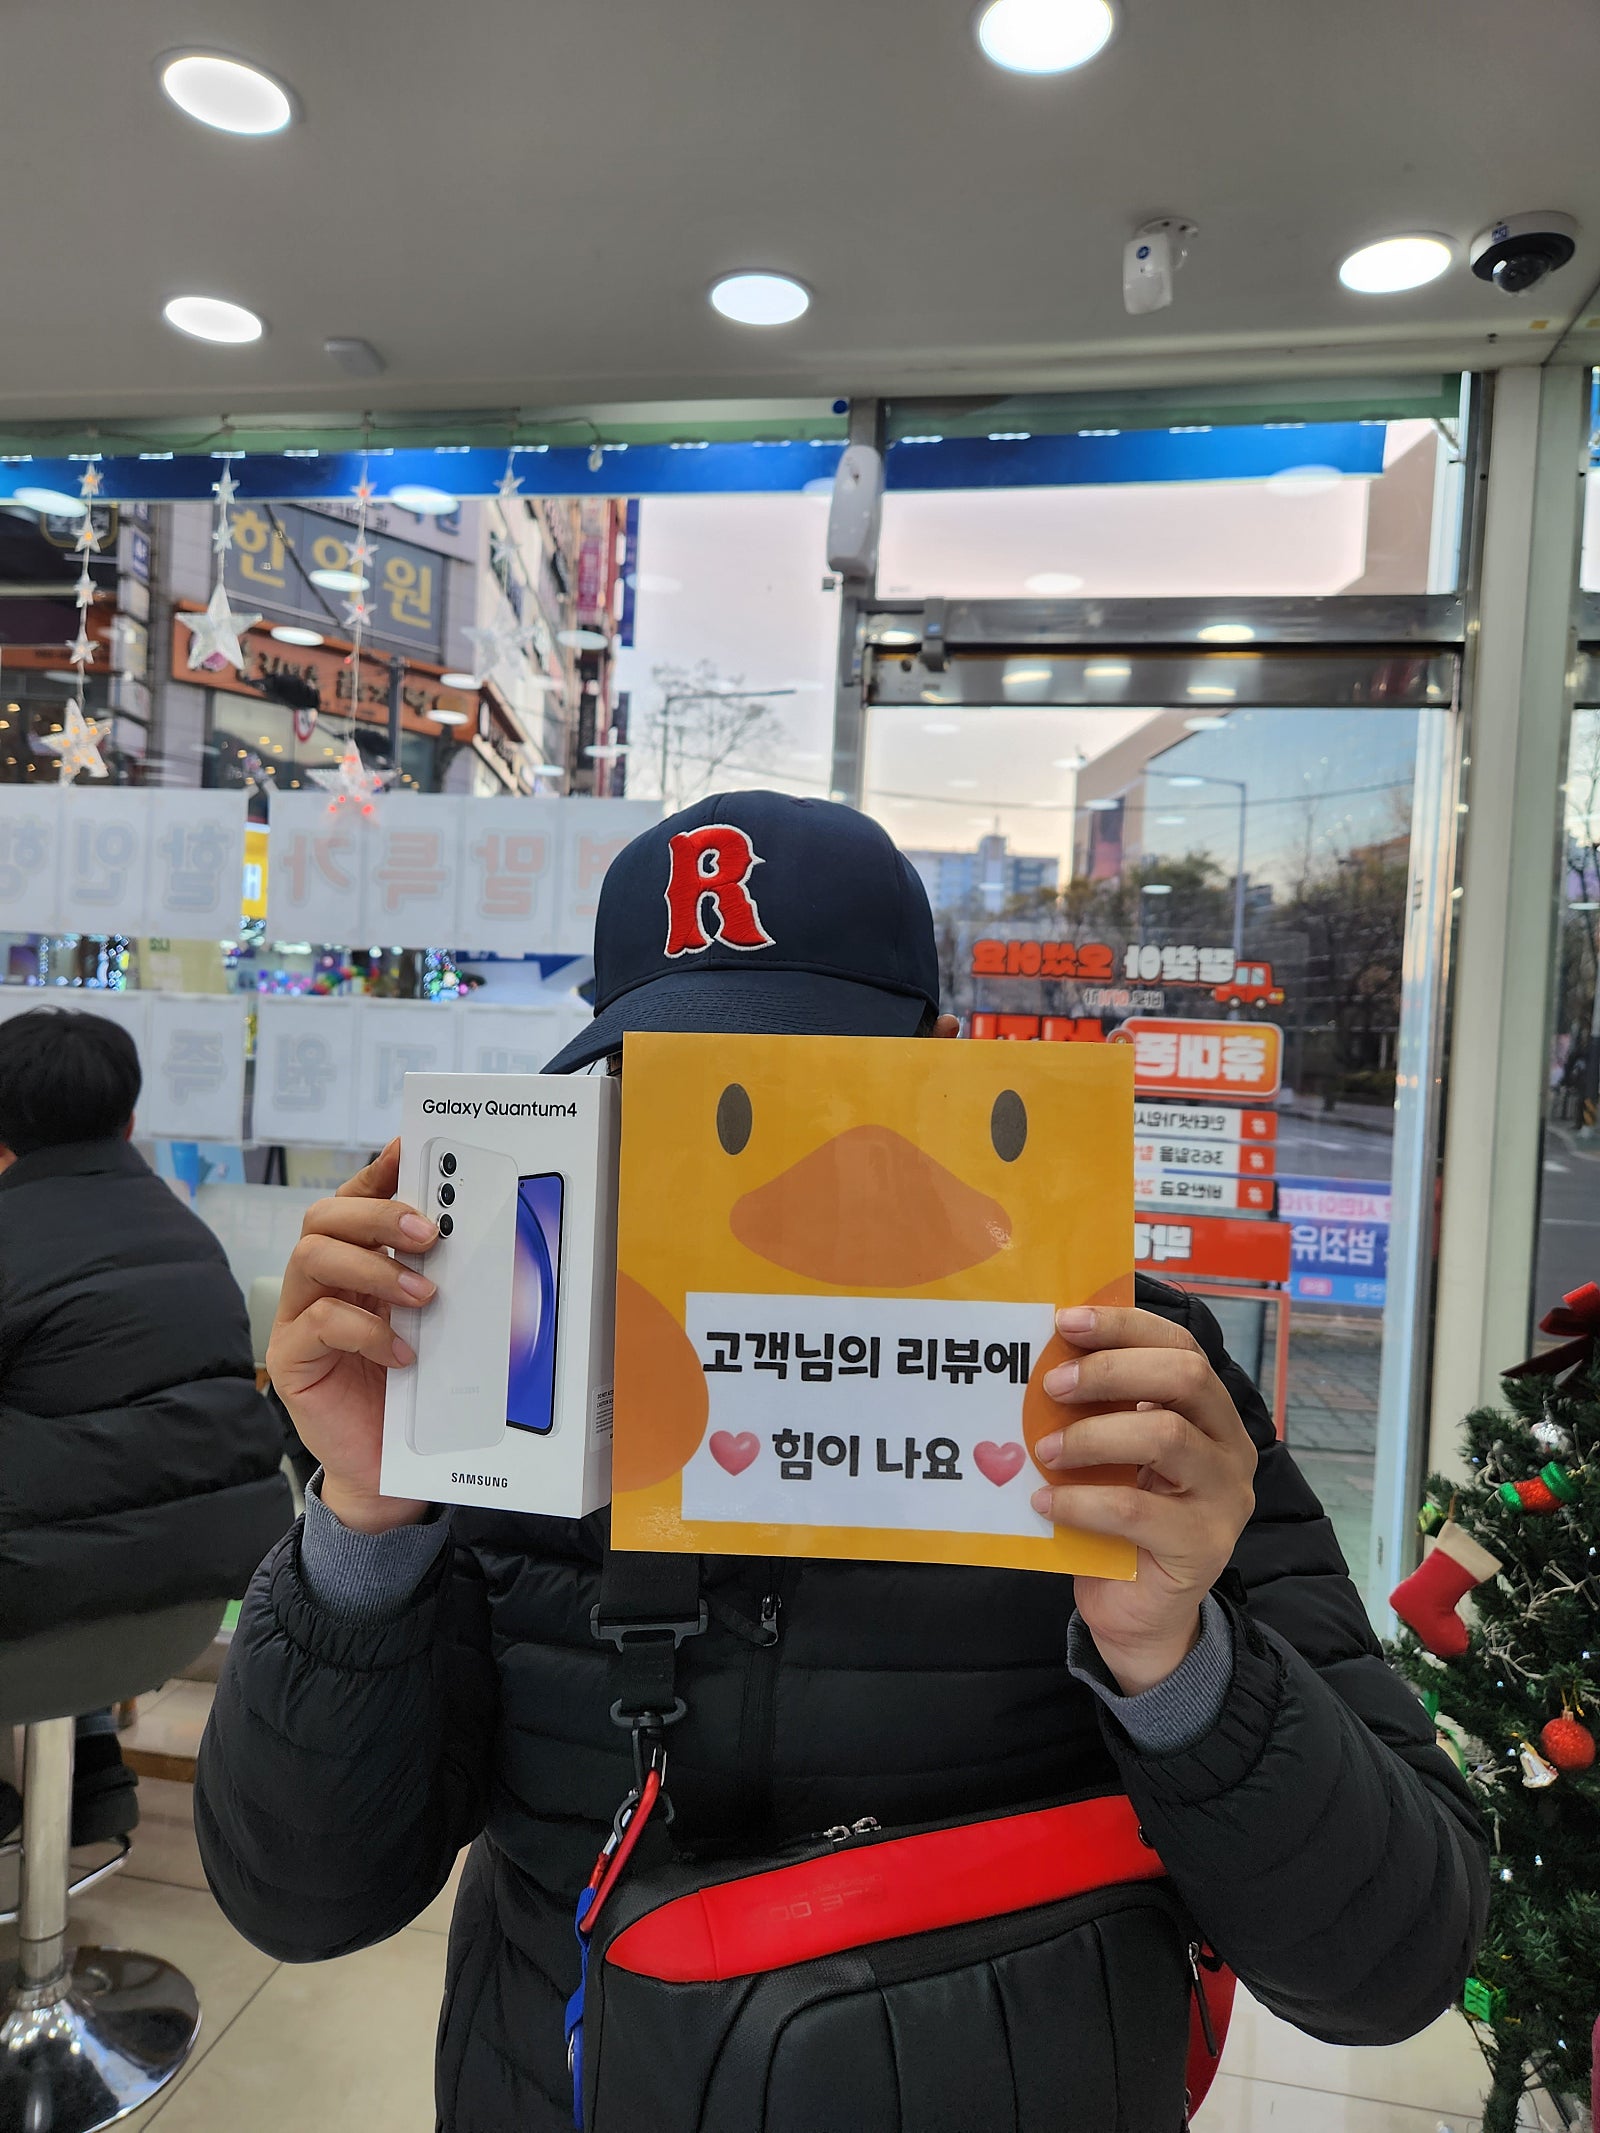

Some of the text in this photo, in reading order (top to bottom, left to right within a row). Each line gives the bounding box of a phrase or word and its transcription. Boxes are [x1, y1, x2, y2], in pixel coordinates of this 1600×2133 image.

[664, 824, 776, 959] R
[422, 1099, 578, 1119] Galaxy Quantum4
[702, 1331, 1031, 1385] 고객님의 리뷰에
[451, 1471, 509, 1488] SAMSUNG
[771, 1428, 963, 1480] 힘이 나요
